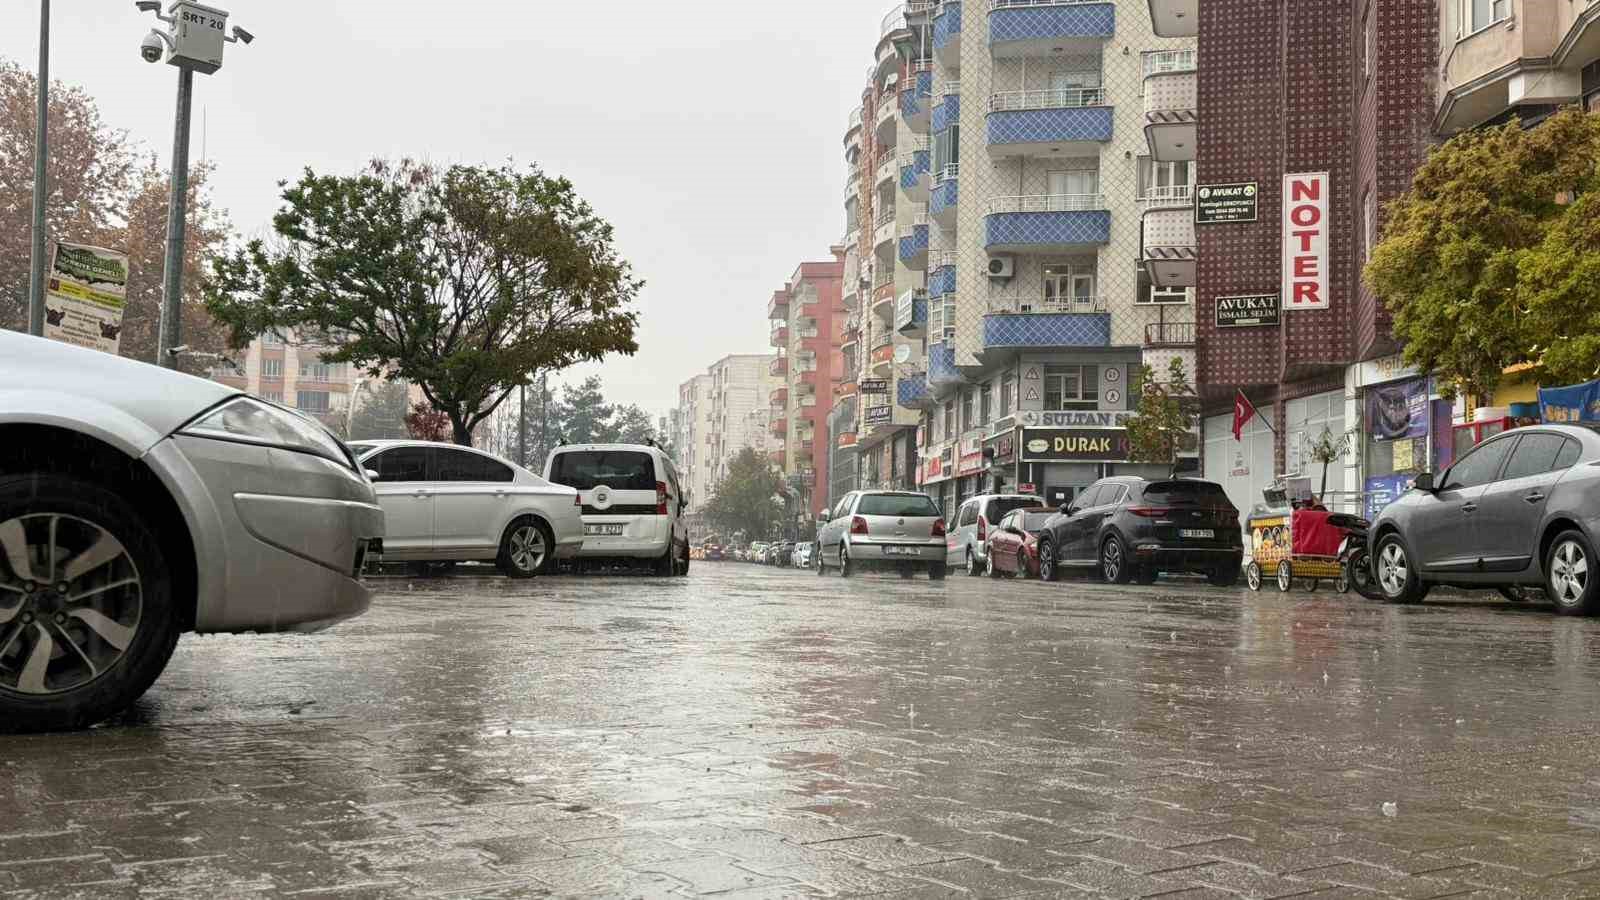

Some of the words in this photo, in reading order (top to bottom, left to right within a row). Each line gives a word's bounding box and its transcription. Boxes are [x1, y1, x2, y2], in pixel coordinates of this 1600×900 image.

[183, 11, 206, 25] SRT
[209, 19, 224, 31] 20
[1212, 188, 1243, 197] AVUKAT
[1290, 178, 1321, 304] NOTER
[1218, 297, 1276, 309] AVUKAT
[1042, 412, 1111, 426] SULTAN
[1054, 437, 1111, 452] DURAK
